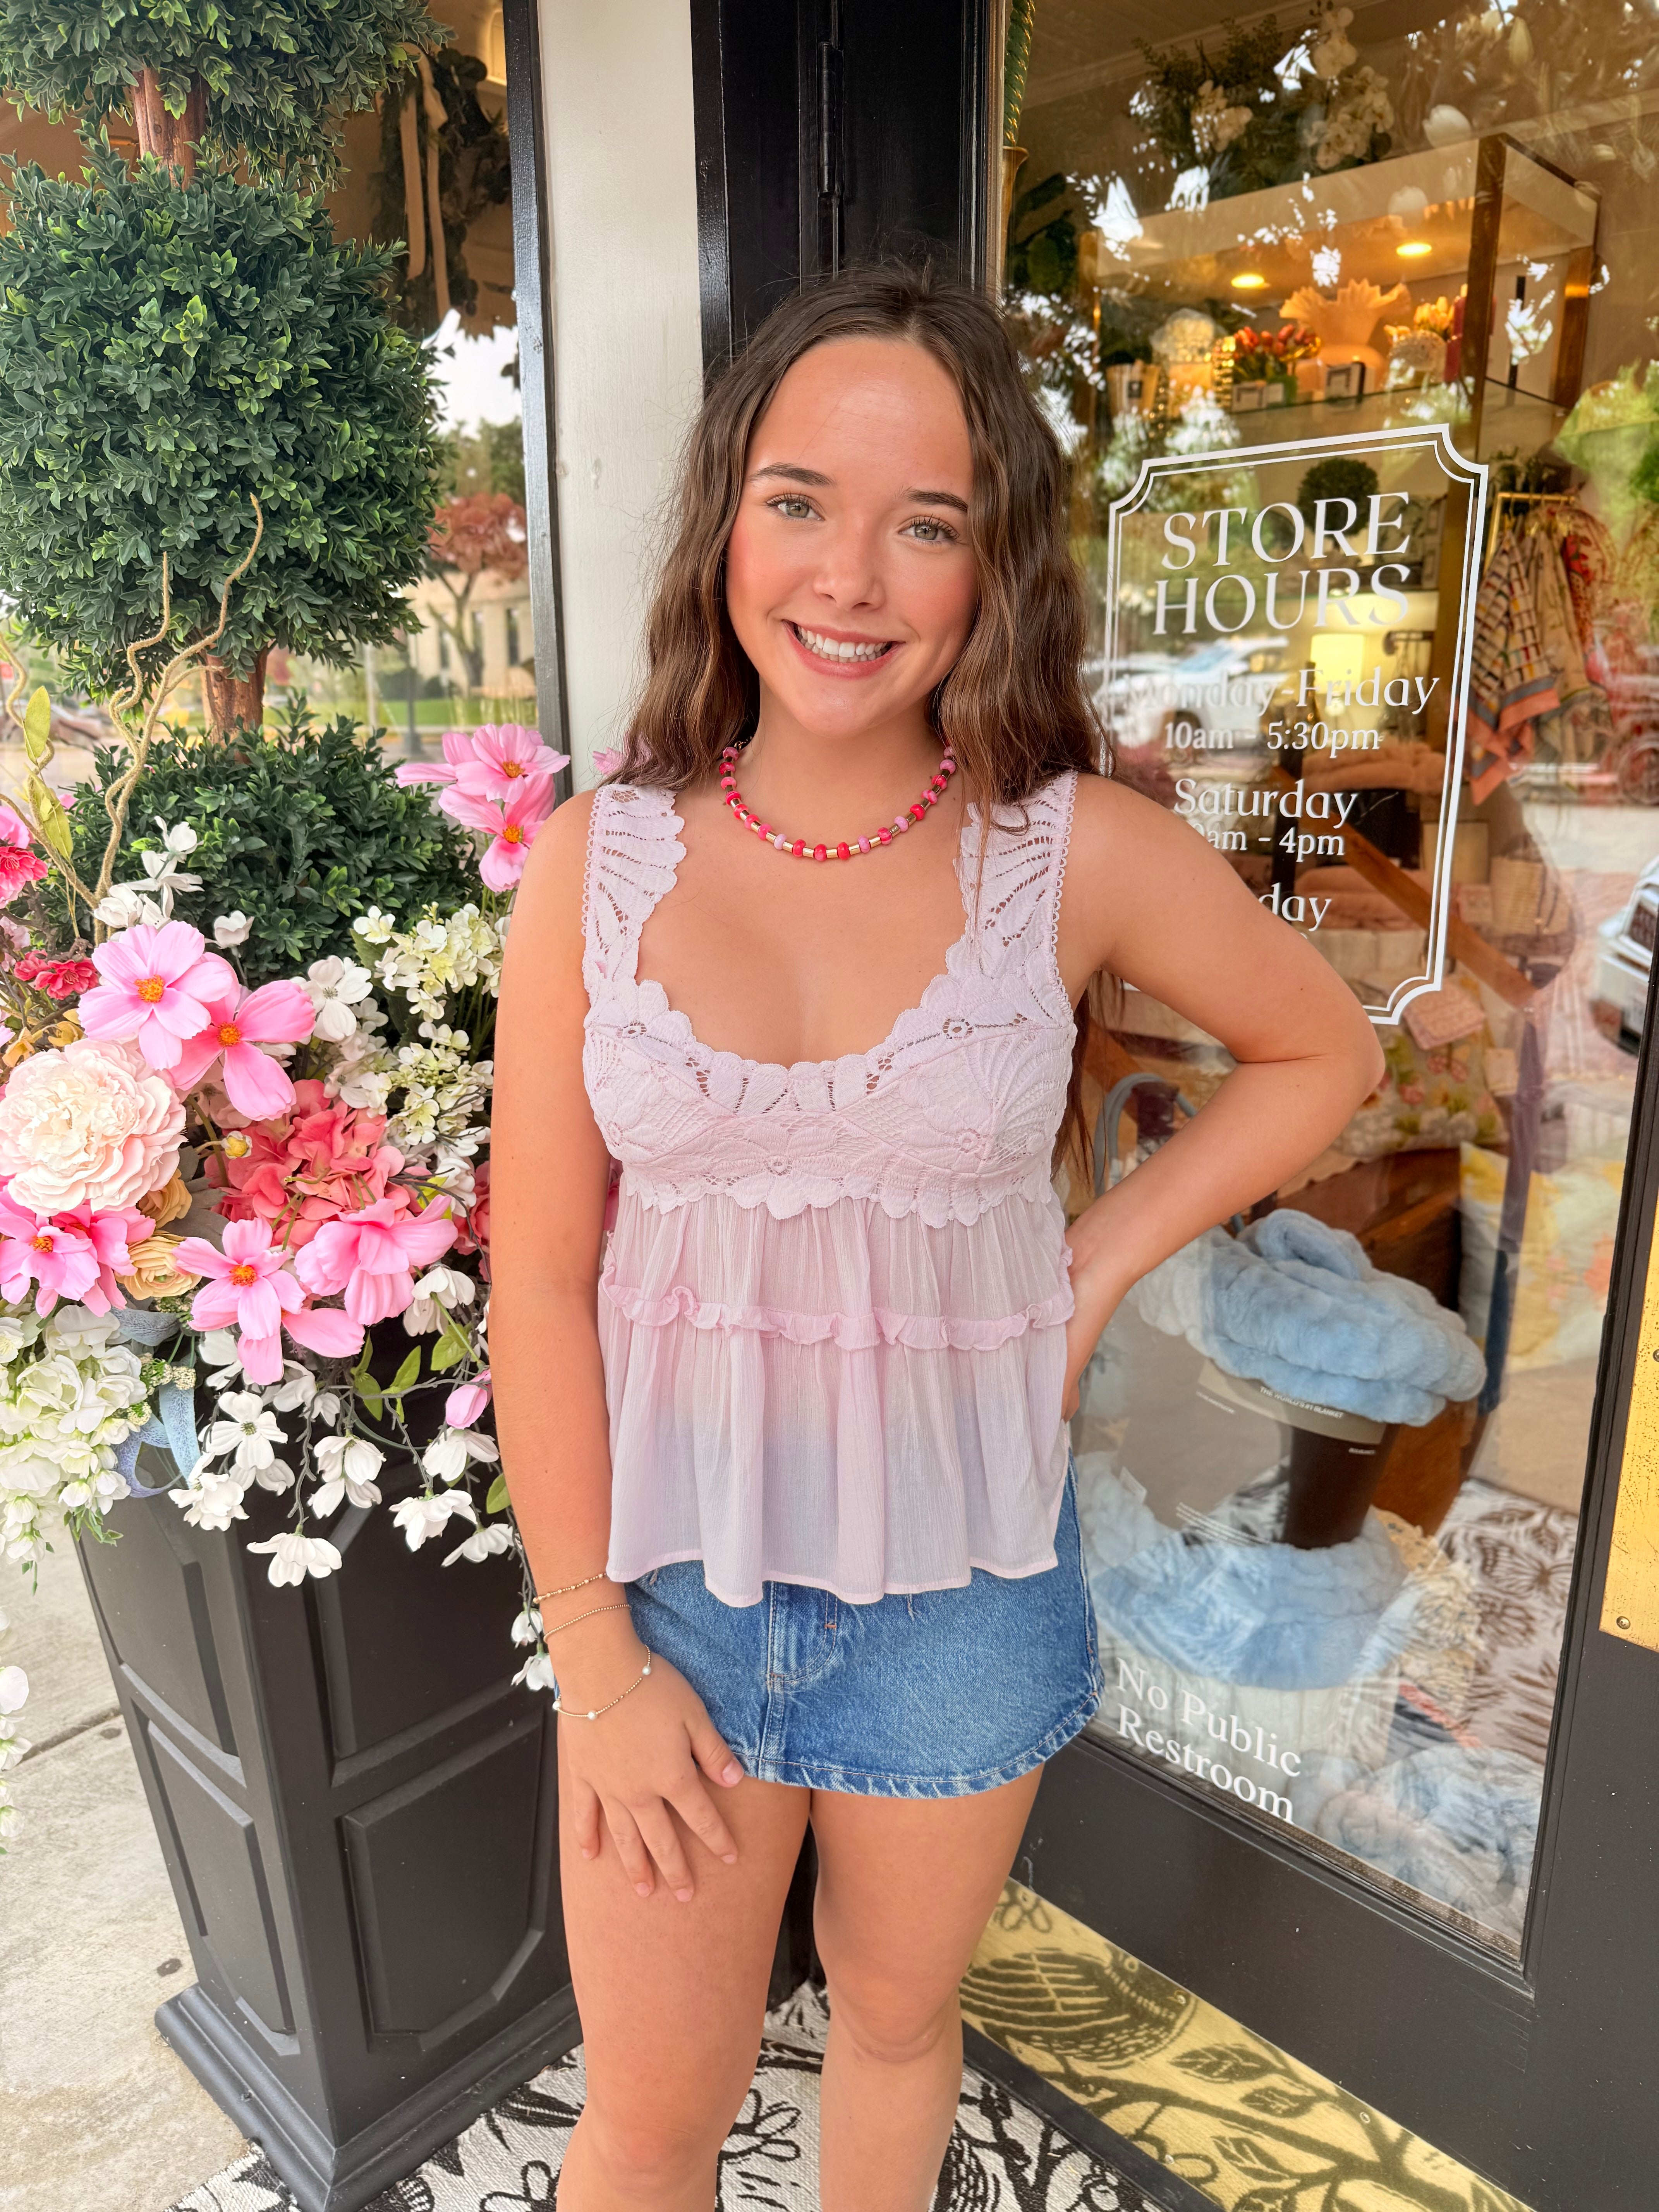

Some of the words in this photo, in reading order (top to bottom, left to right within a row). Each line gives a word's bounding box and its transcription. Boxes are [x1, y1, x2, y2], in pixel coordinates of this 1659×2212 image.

[1161, 492, 1410, 570] STORE
[1152, 564, 1411, 635] HOURS
[1165, 721, 1233, 749] 10am
[1267, 720, 1379, 759] 5:30pm
[1173, 778, 1358, 829] Saturday
[1279, 826, 1345, 862] 4pm
[1260, 1386, 1274, 1397] THE
[1116, 1657, 1168, 1710] No
[1180, 1689, 1302, 1778] Public
[1116, 1703, 1295, 1824] Restroom
